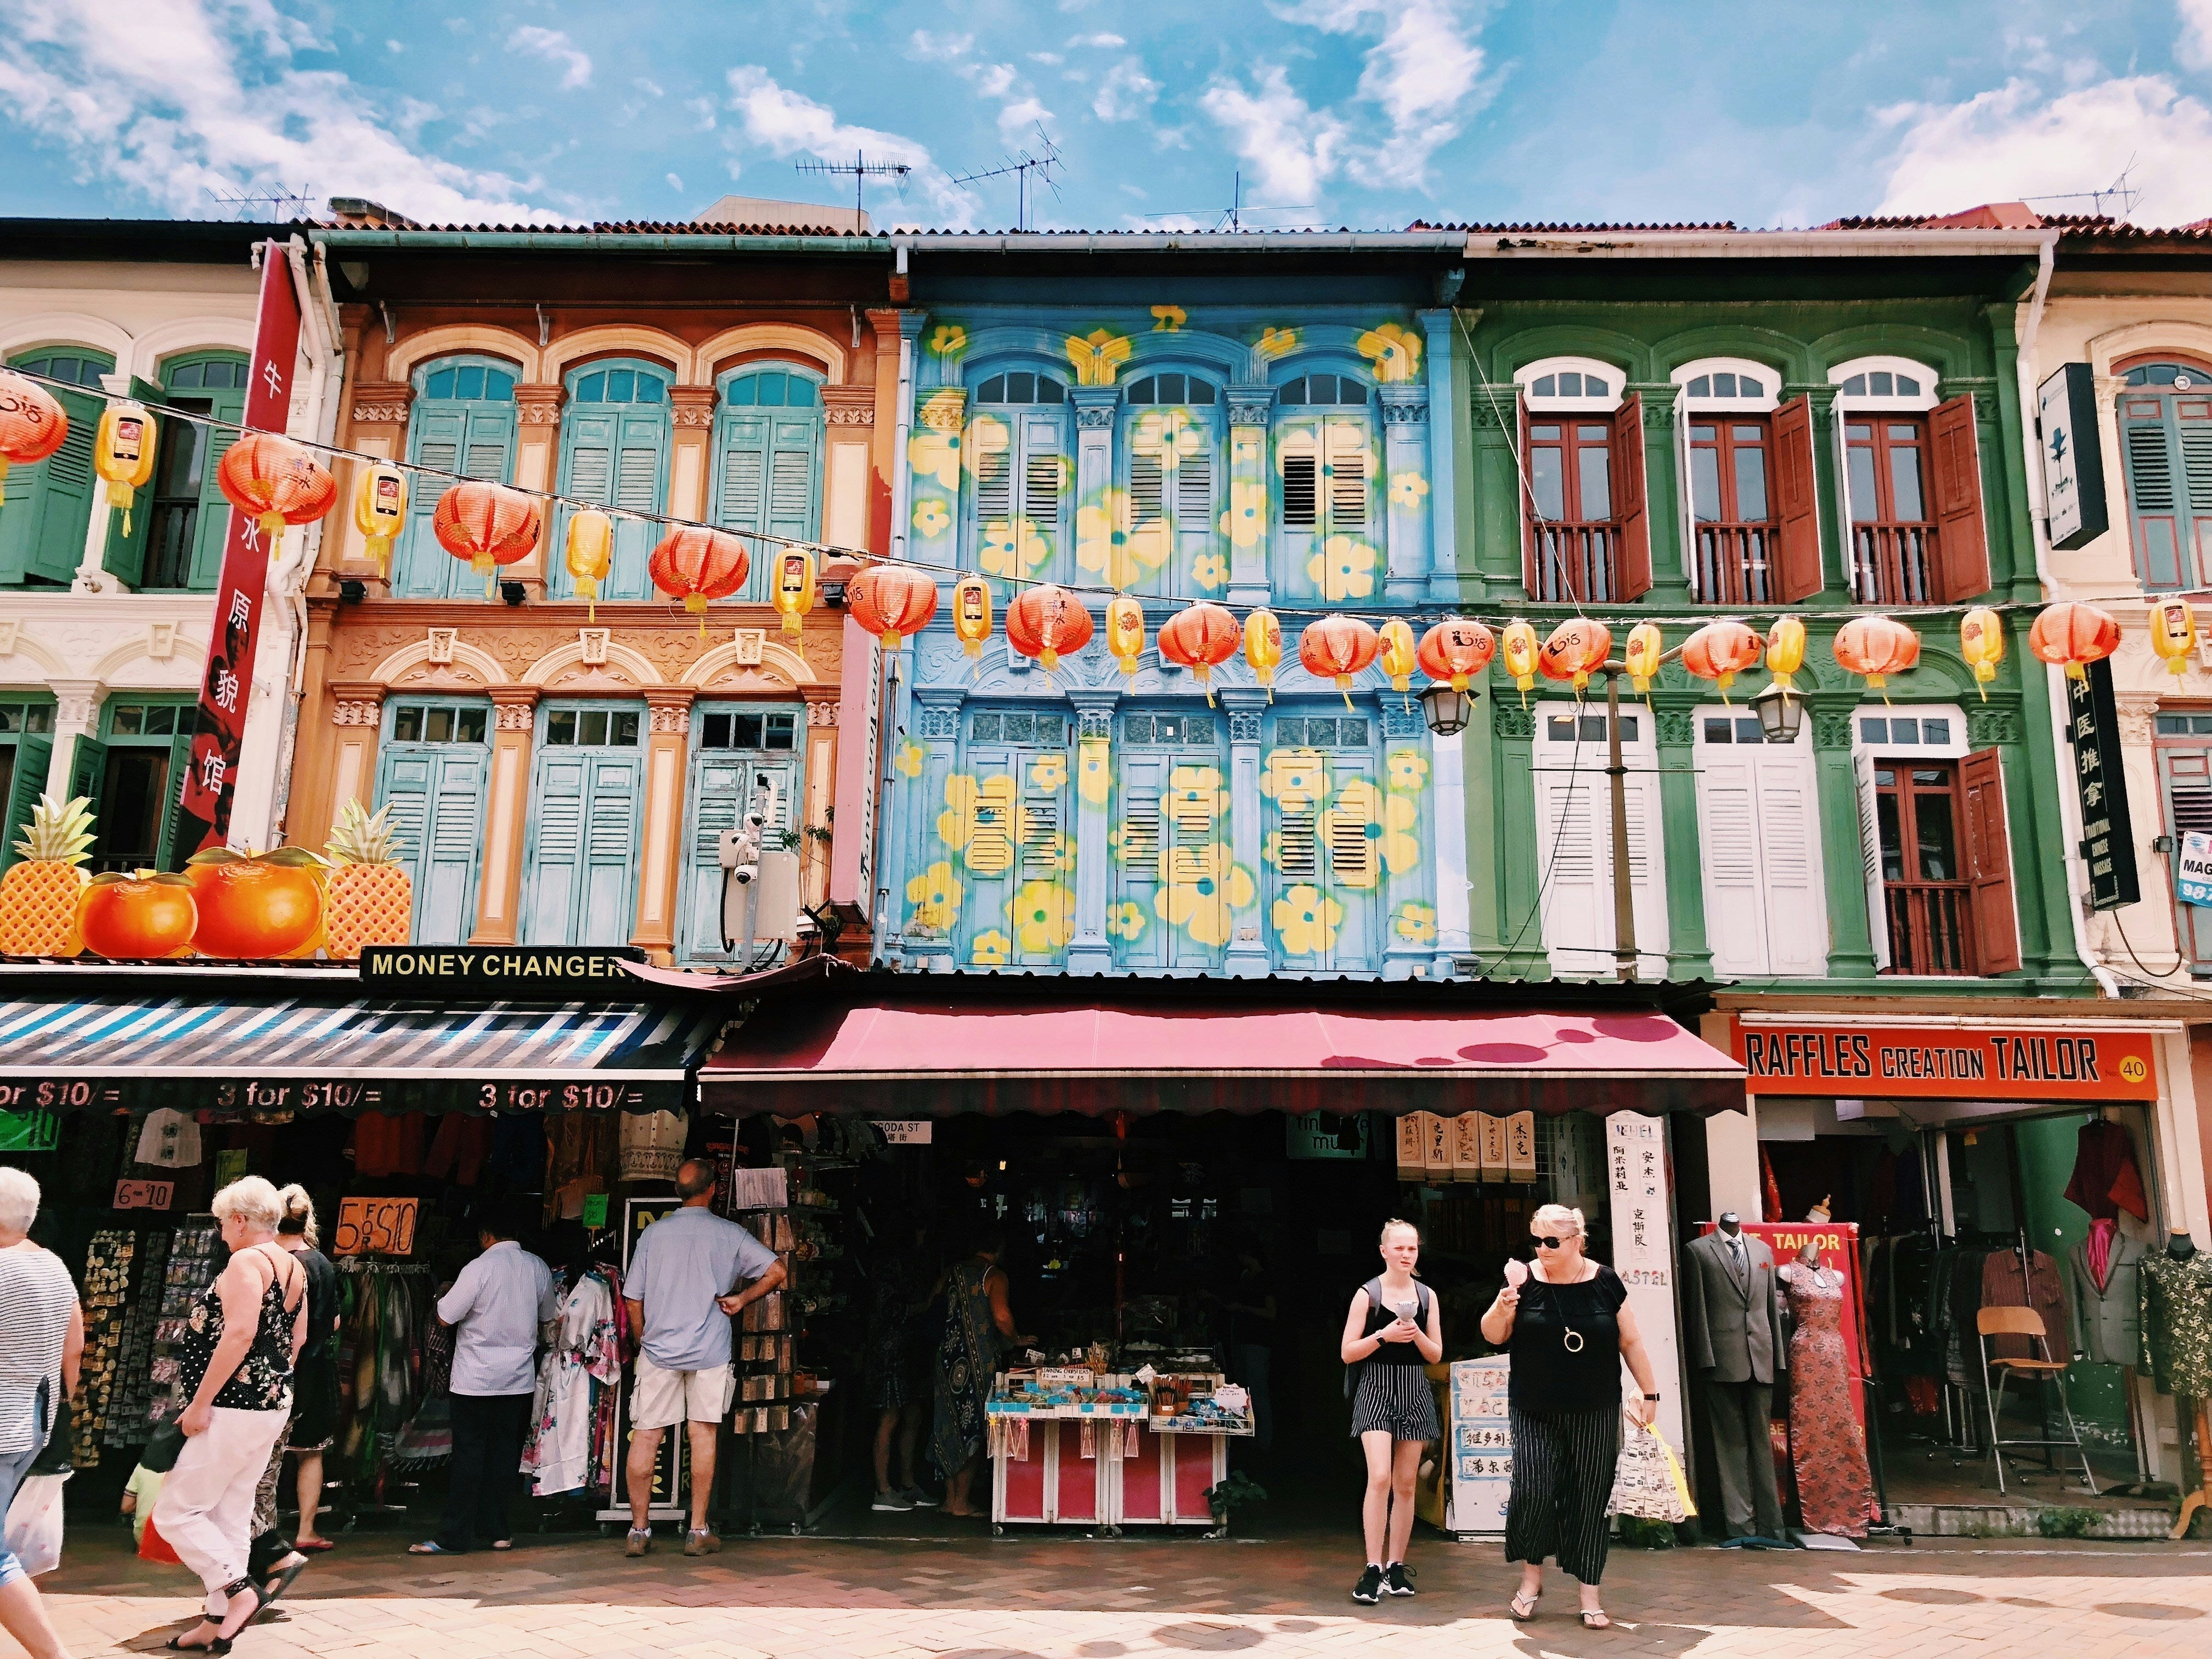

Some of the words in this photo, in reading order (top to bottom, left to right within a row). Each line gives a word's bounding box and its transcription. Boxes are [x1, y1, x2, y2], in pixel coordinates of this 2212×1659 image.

[2073, 680, 2103, 807] 中医推拿
[2093, 857, 2113, 877] MASSAGE
[372, 953, 476, 976] MONEY
[482, 955, 626, 977] CHANGER
[1745, 1033, 1872, 1078] RAFFLES
[1879, 1047, 1986, 1081] CREATION
[1990, 1036, 2101, 1082] TAILOR
[2122, 1060, 2145, 1077] 40
[0, 1085, 26, 1105] or
[218, 1082, 235, 1106] 3
[246, 1082, 290, 1107] for
[479, 1084, 496, 1108] 3
[507, 1084, 551, 1109] for
[888, 1133, 907, 1142] 塔街
[907, 1122, 920, 1132] ST
[1613, 1146, 1629, 1191] 阿米莉亚
[335, 1203, 359, 1250] 5
[1772, 1233, 1841, 1250] TAILOR
[1466, 1431, 1513, 1447] 维多利
